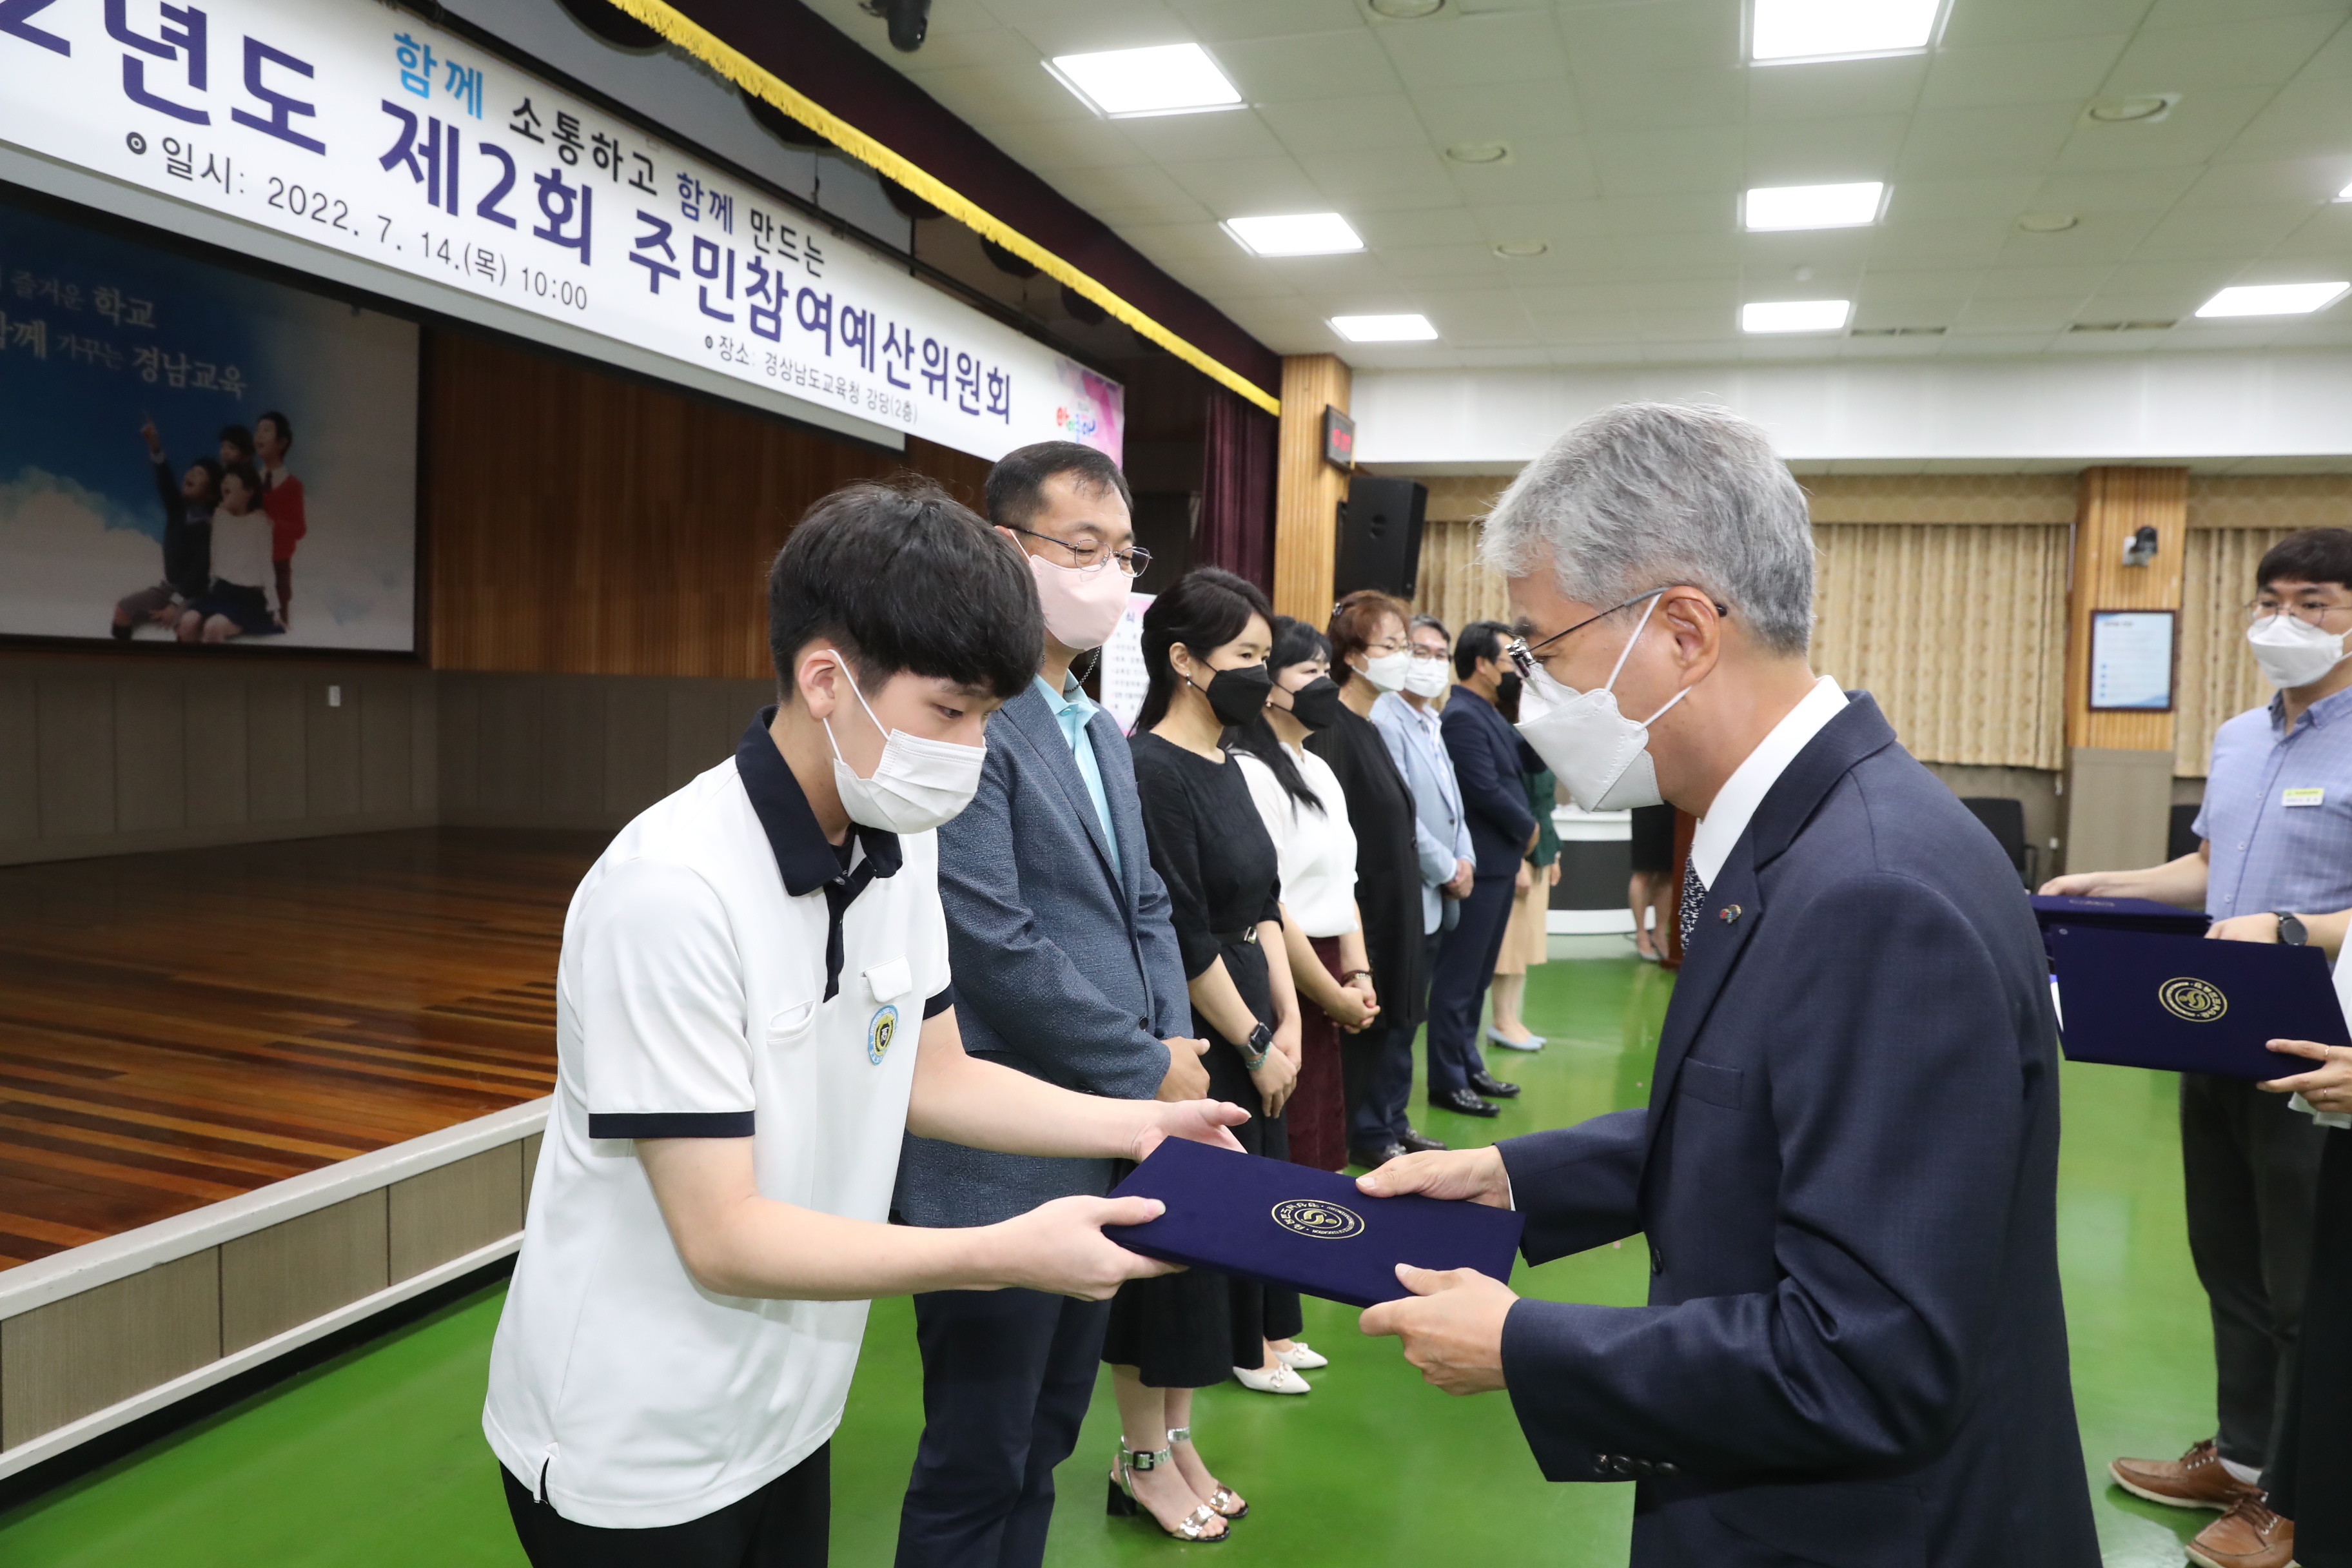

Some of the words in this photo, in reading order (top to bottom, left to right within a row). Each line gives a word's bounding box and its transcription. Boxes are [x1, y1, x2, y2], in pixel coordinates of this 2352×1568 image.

[395, 33, 483, 121] 함께
[509, 97, 658, 197] 소통하고
[677, 172, 733, 235] 함께
[750, 208, 825, 279] 만드는
[268, 176, 359, 237] 2022.
[378, 215, 402, 251] 7.
[421, 231, 507, 287] 14.(목)
[522, 267, 588, 311] 10:00
[378, 99, 593, 267] 제2회
[629, 208, 1010, 425] 주민참여예산위원회
[10, 269, 86, 312] 즐거운
[92, 284, 157, 329] 학교
[55, 331, 124, 371] 가꾸는
[132, 344, 248, 401] 경남교육
[765, 351, 861, 406] 경상남도교육청
[866, 387, 918, 425] 강당(2층)
